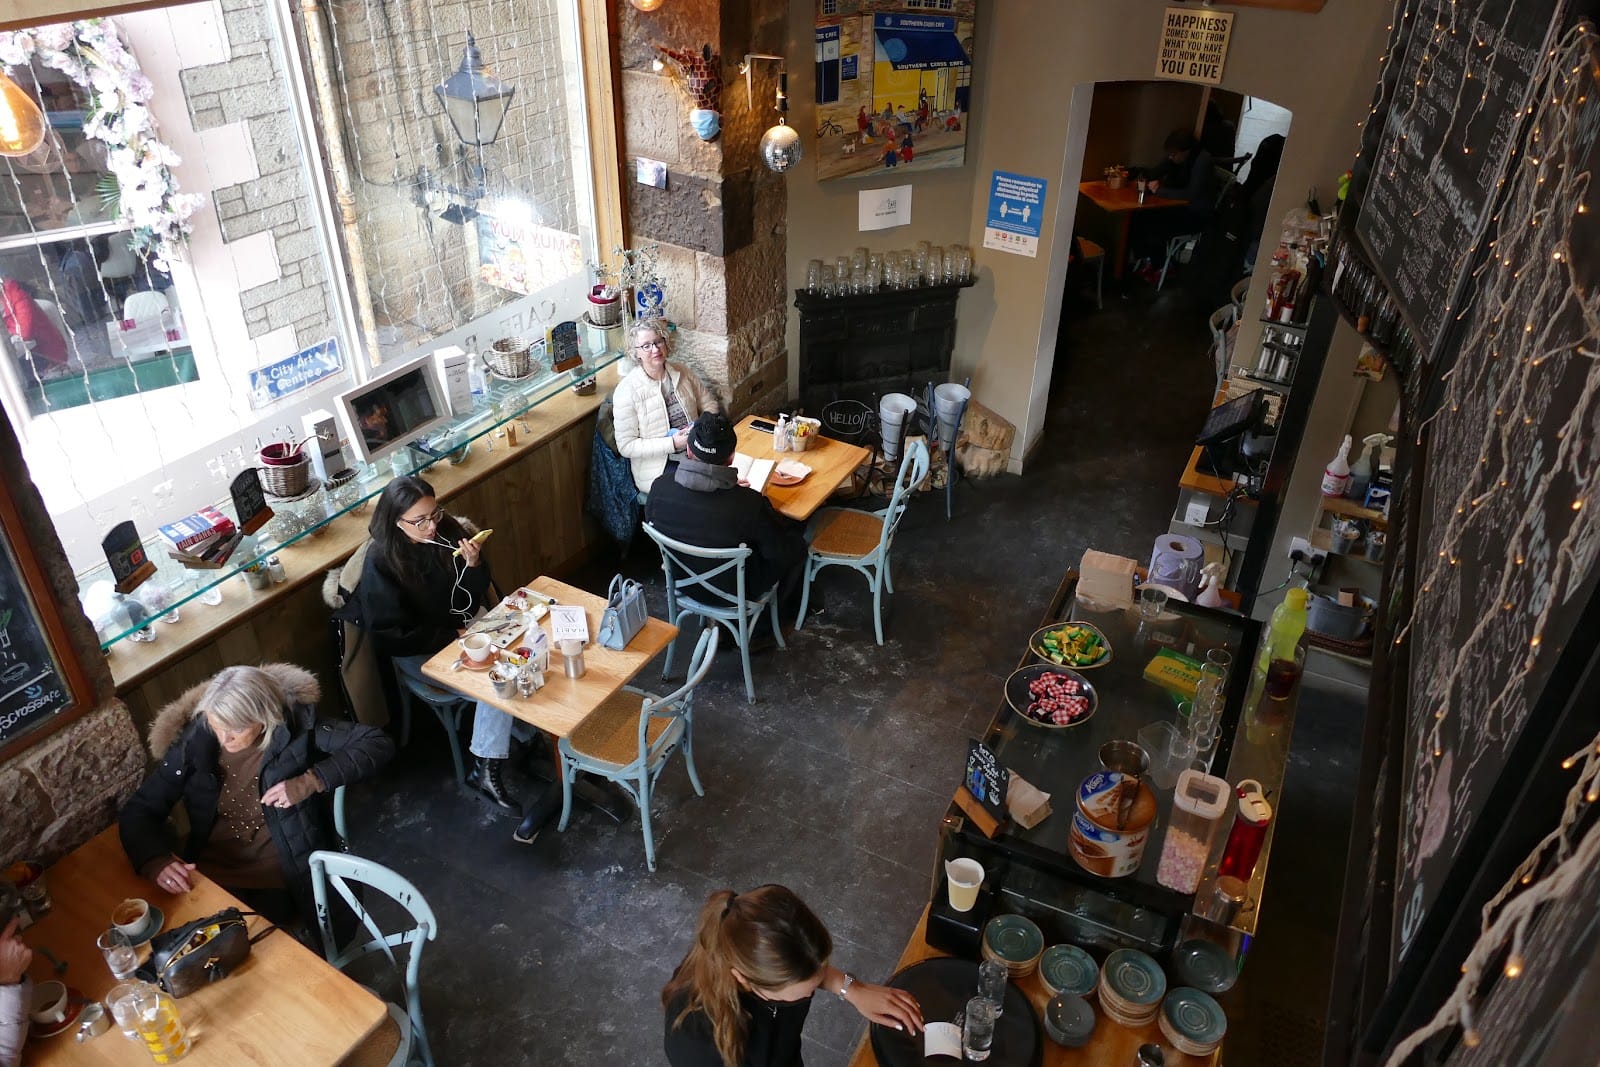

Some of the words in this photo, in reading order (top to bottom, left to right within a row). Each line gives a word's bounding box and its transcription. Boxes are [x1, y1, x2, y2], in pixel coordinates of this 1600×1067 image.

[1167, 14, 1228, 32] HAPPINESS
[1165, 28, 1189, 39] COMES
[1190, 31, 1203, 40] NOT
[1205, 33, 1225, 42] FROM
[1164, 38, 1185, 48] WHAT
[1187, 41, 1202, 51] YOU
[1204, 43, 1223, 53] HAVE
[1162, 49, 1177, 58] BUT
[1178, 51, 1196, 60] HOW
[1198, 53, 1221, 64] MUCH
[897, 62, 927, 70] SOUTHERN
[1161, 59, 1185, 74] YOU
[1189, 63, 1219, 78] GIVE
[270, 363, 294, 379] City
[297, 353, 313, 369] Art
[276, 367, 322, 390] Centre
[177, 538, 193, 550] IAIN
[194, 529, 217, 544] BANKS
